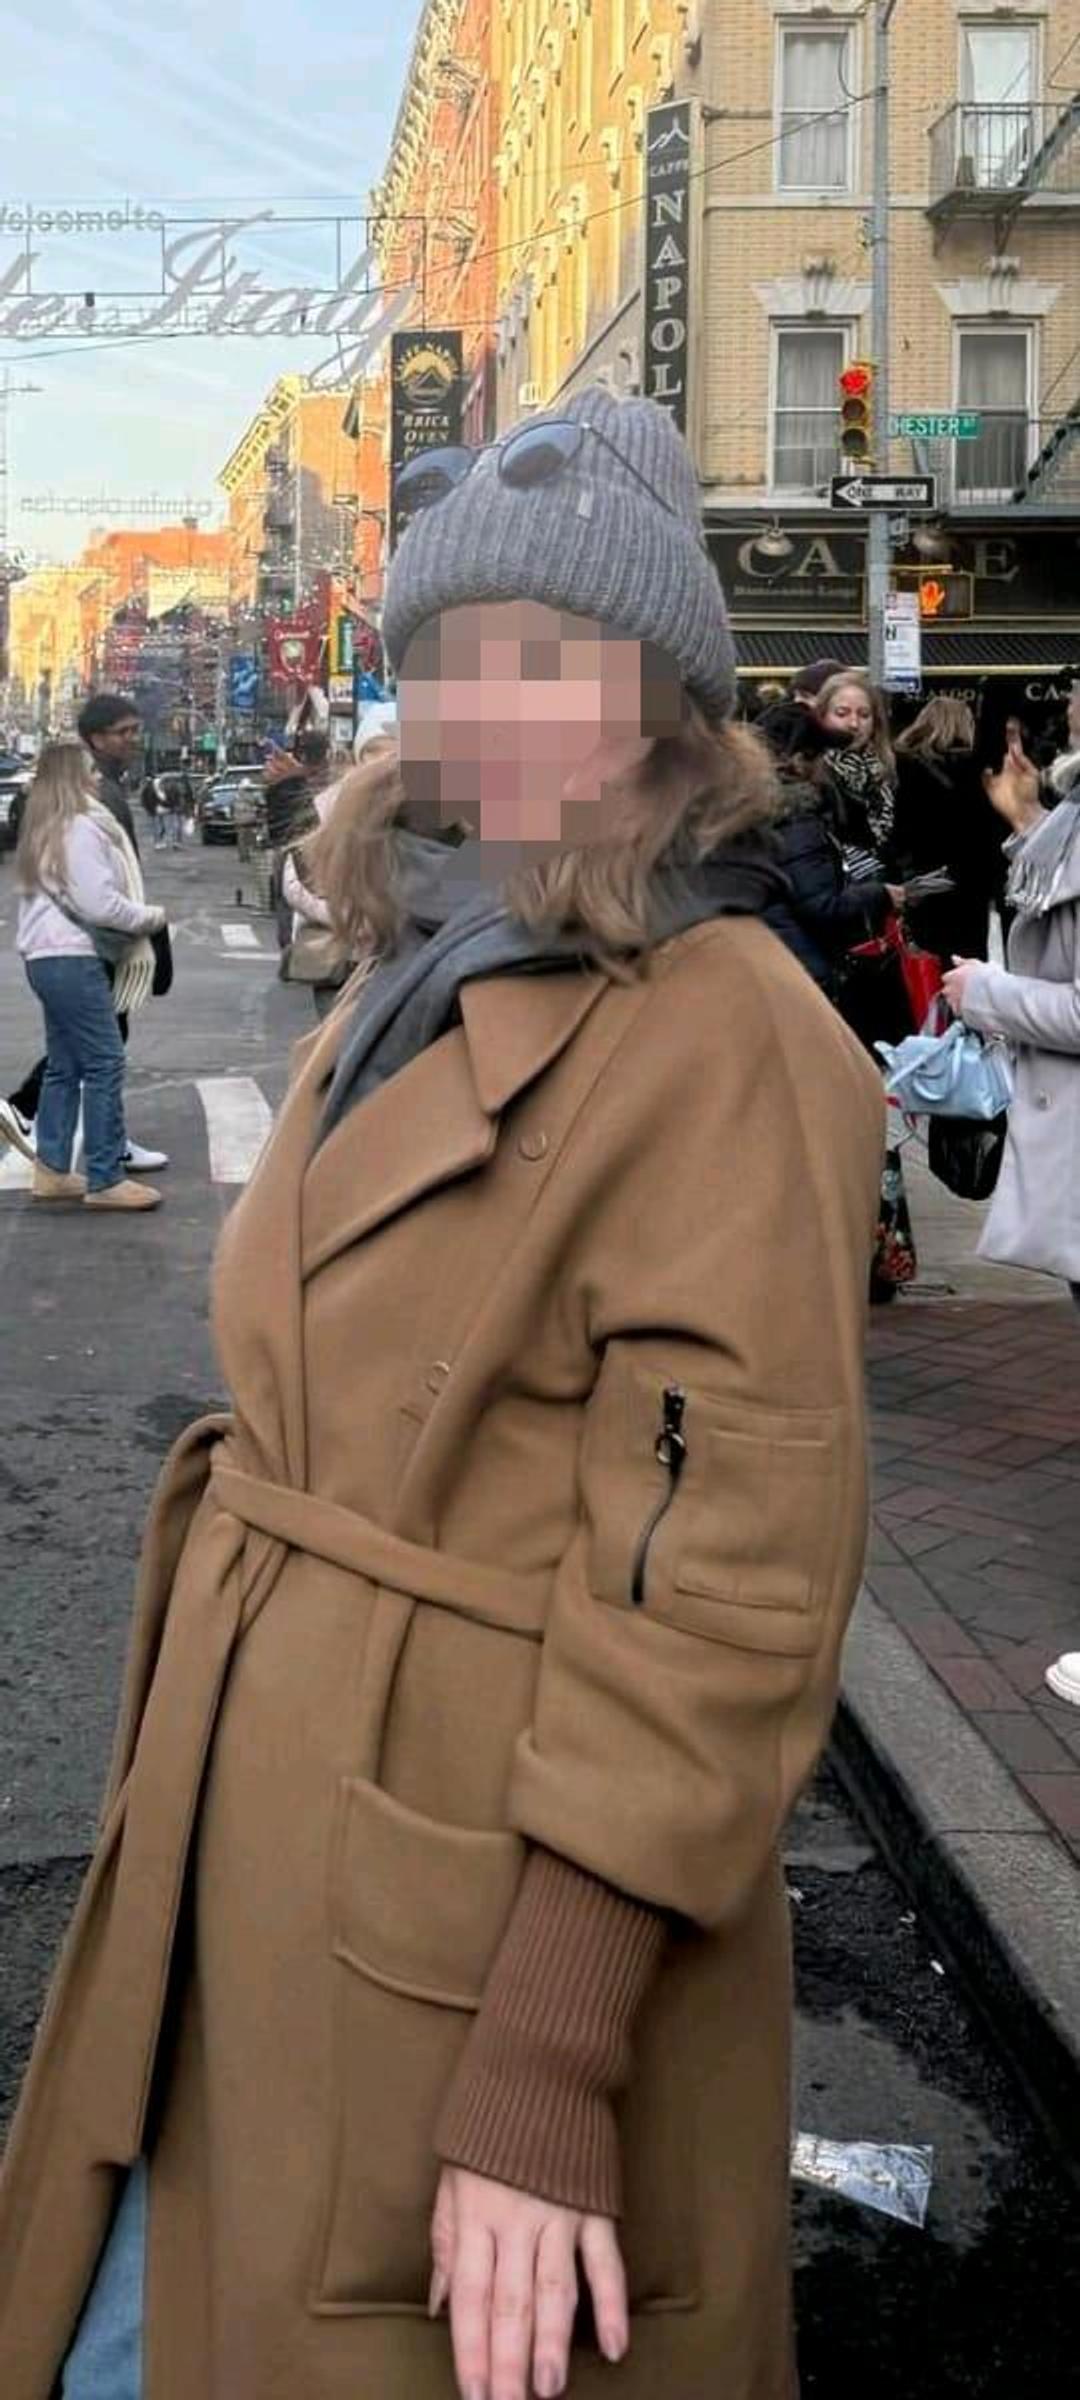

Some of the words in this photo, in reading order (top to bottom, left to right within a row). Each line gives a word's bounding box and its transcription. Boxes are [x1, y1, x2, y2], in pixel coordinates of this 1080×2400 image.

[0, 203, 123, 232] elcome
[133, 207, 164, 231] to
[140, 210, 418, 391] Italy
[846, 485, 874, 499] ONE
[895, 486, 922, 499] WAY
